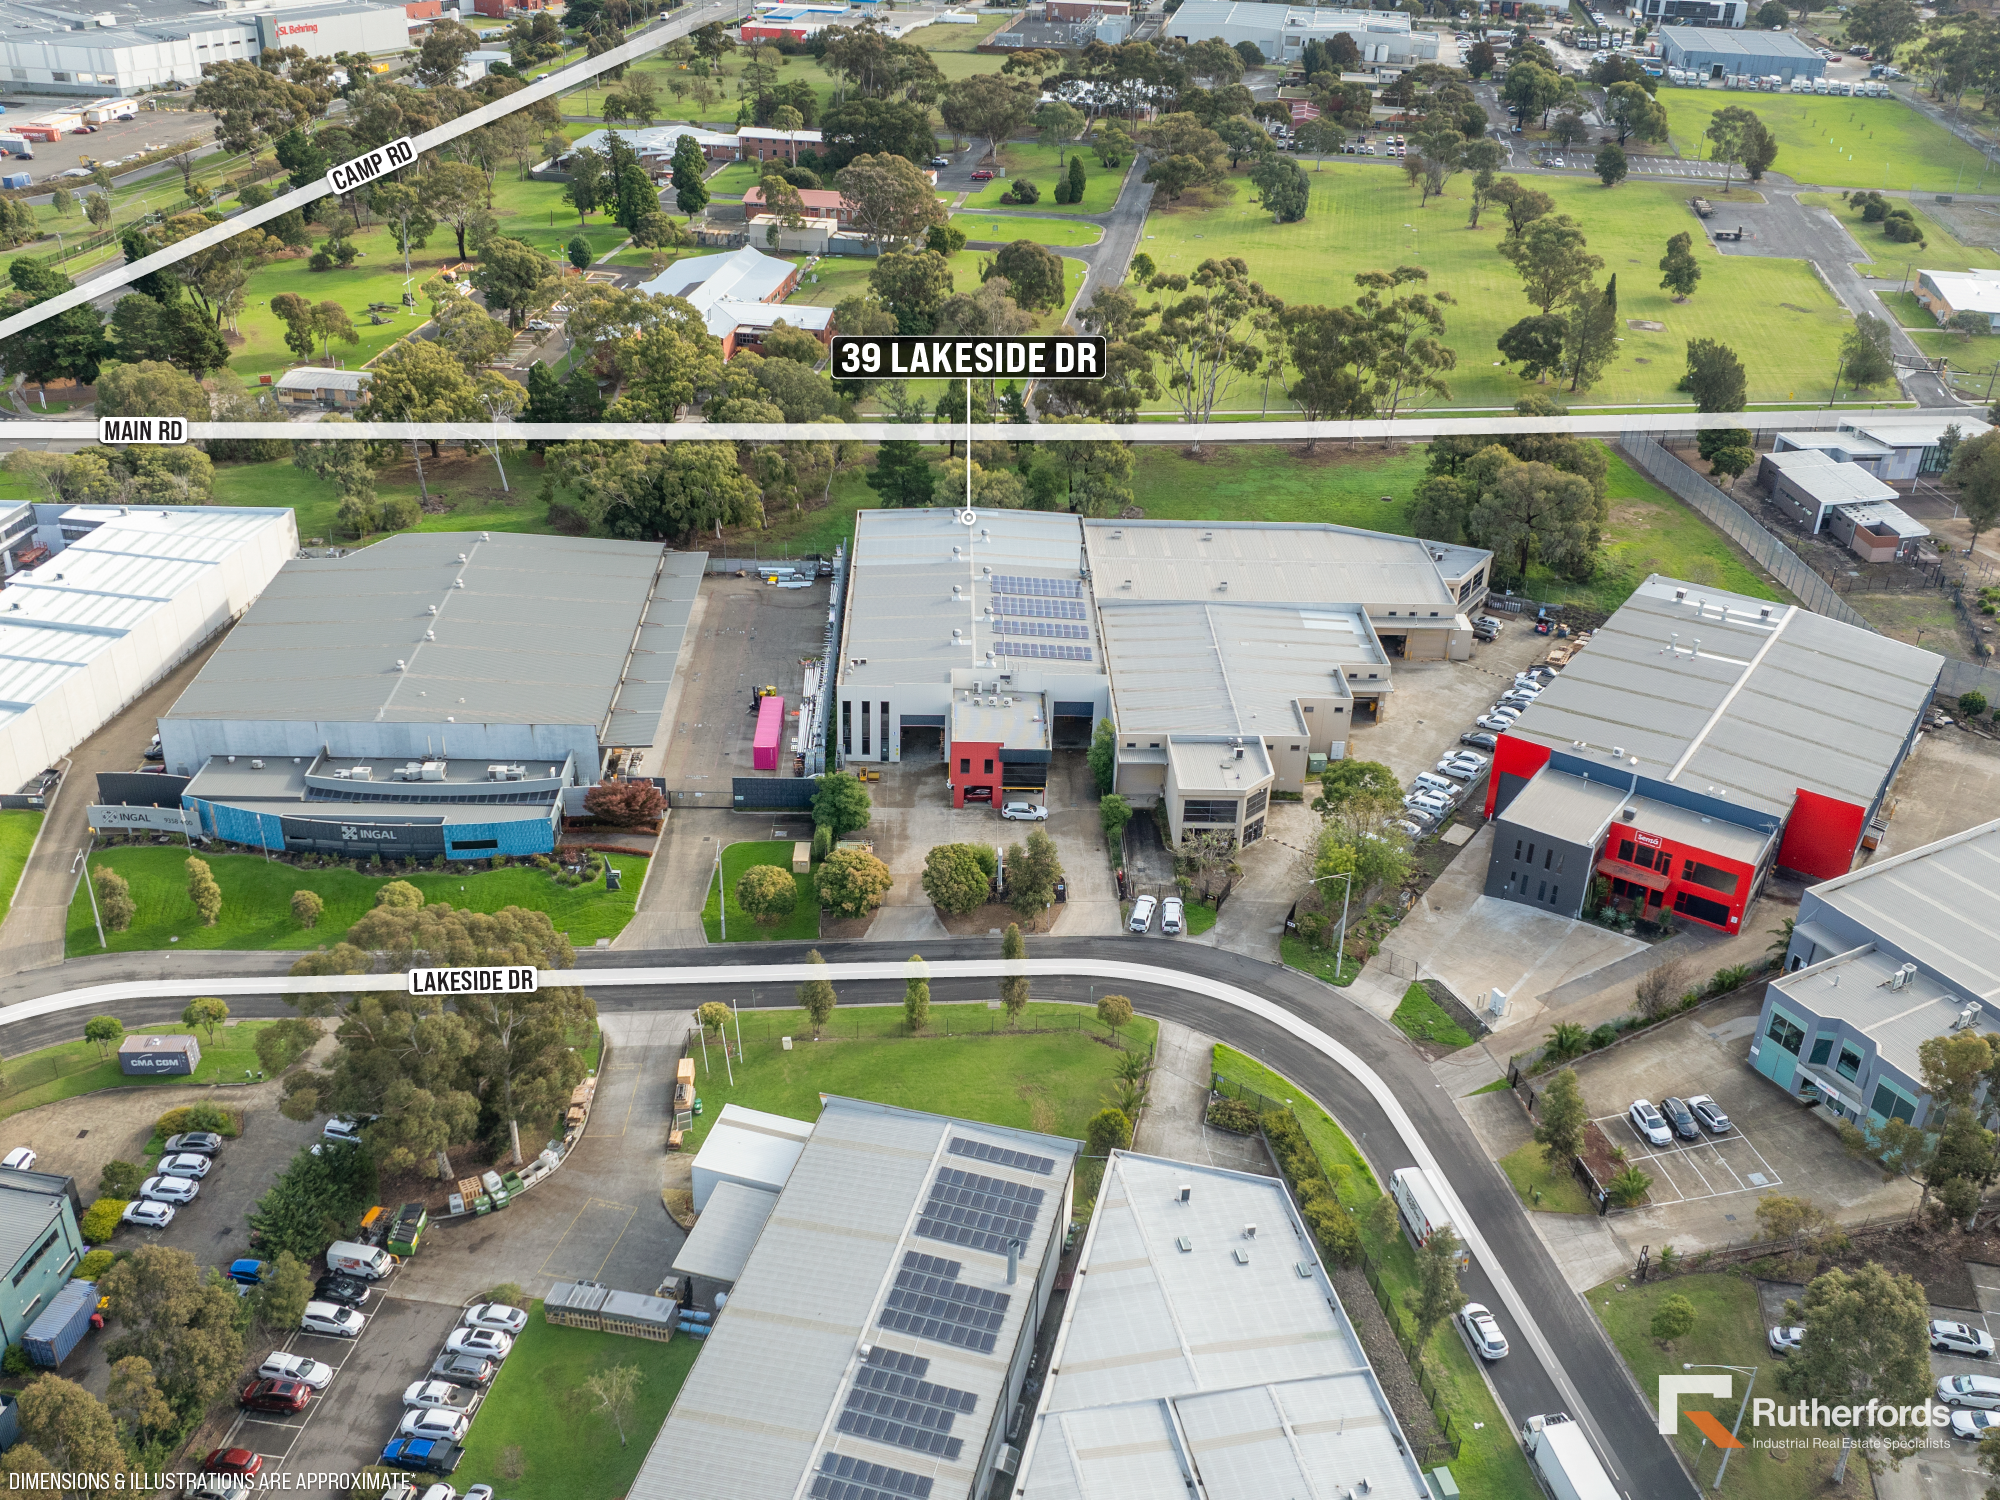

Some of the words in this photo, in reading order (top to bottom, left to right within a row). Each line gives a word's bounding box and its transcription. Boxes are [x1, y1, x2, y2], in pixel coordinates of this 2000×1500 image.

[289, 23, 318, 34] Behring
[119, 813, 151, 823] INGAL
[360, 829, 397, 840] INGAL
[130, 1059, 154, 1067] CMA
[155, 1059, 179, 1067] CGM
